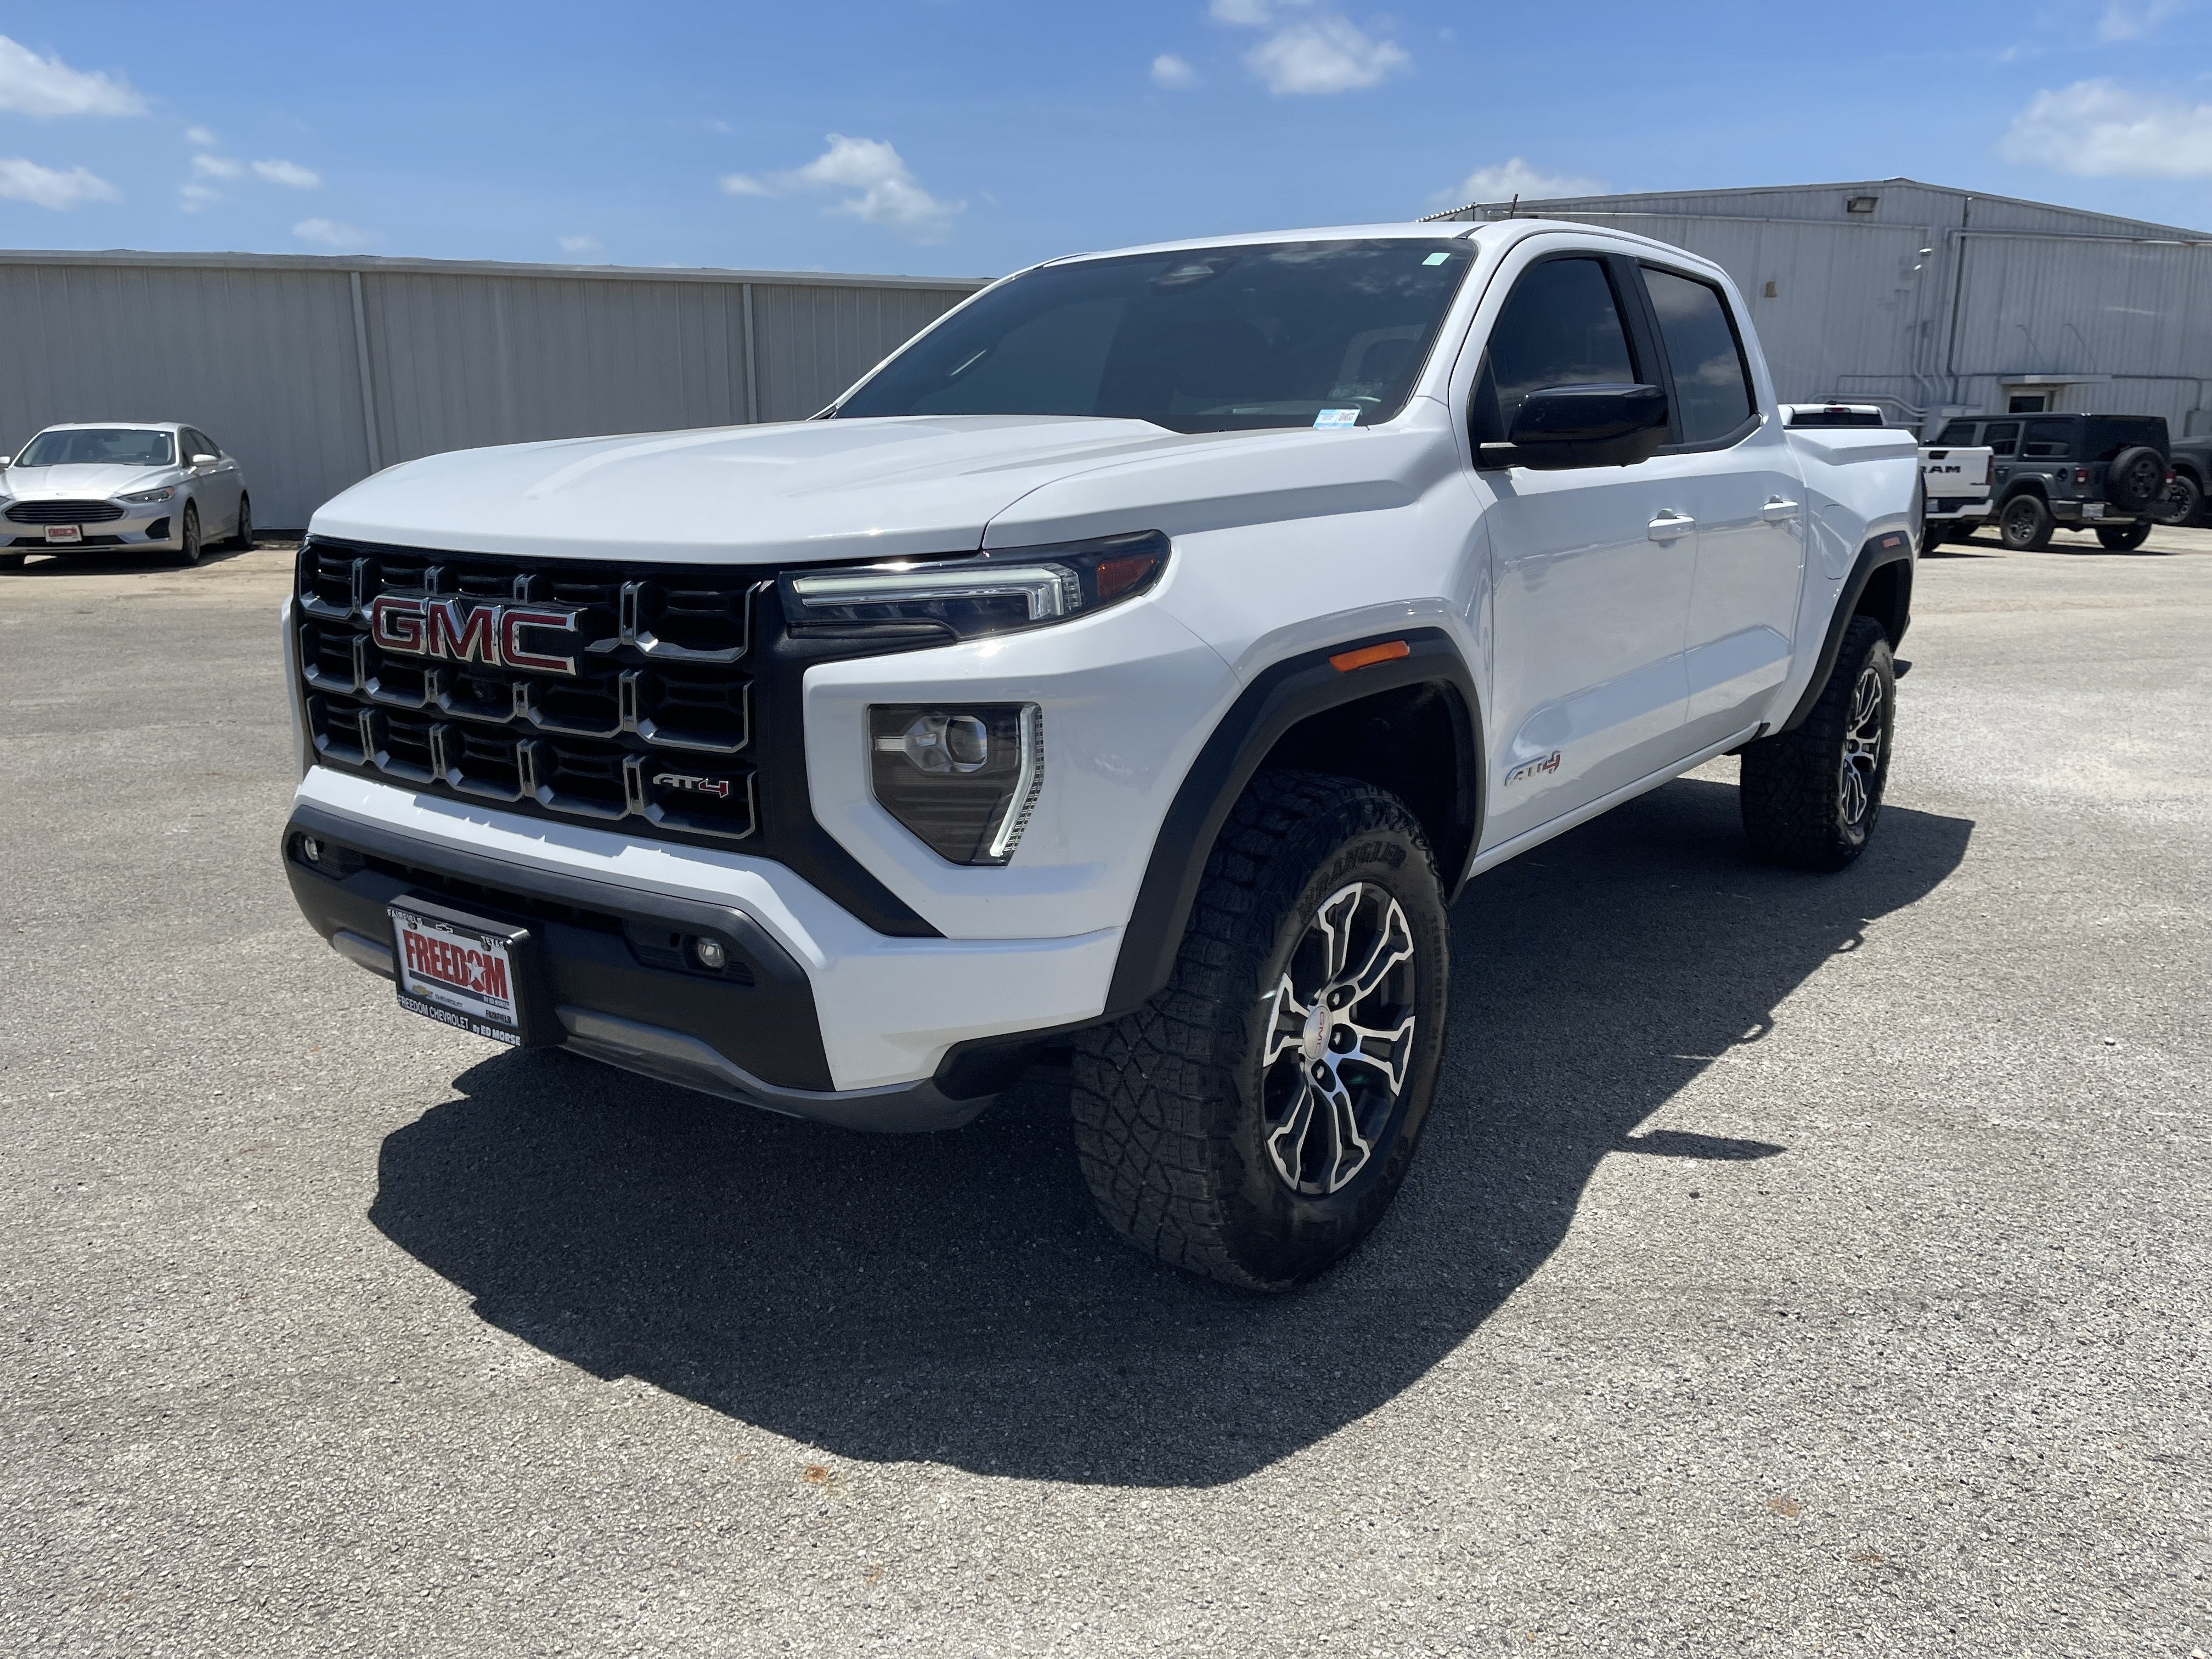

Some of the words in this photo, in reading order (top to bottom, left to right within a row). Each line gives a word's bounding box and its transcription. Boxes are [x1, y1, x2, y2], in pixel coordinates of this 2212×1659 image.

[372, 595, 577, 676] GMC
[653, 773, 729, 798] AT4
[1504, 750, 1561, 787] AT4
[481, 935, 505, 949] TEXAS
[403, 929, 509, 1000] FREEDOM
[398, 994, 429, 1017] FREEDOM
[429, 1006, 469, 1030] CHEVROLET
[481, 1025, 492, 1037] ED
[492, 1029, 521, 1047] MORSE
[1313, 1012, 1324, 1054] GMC
